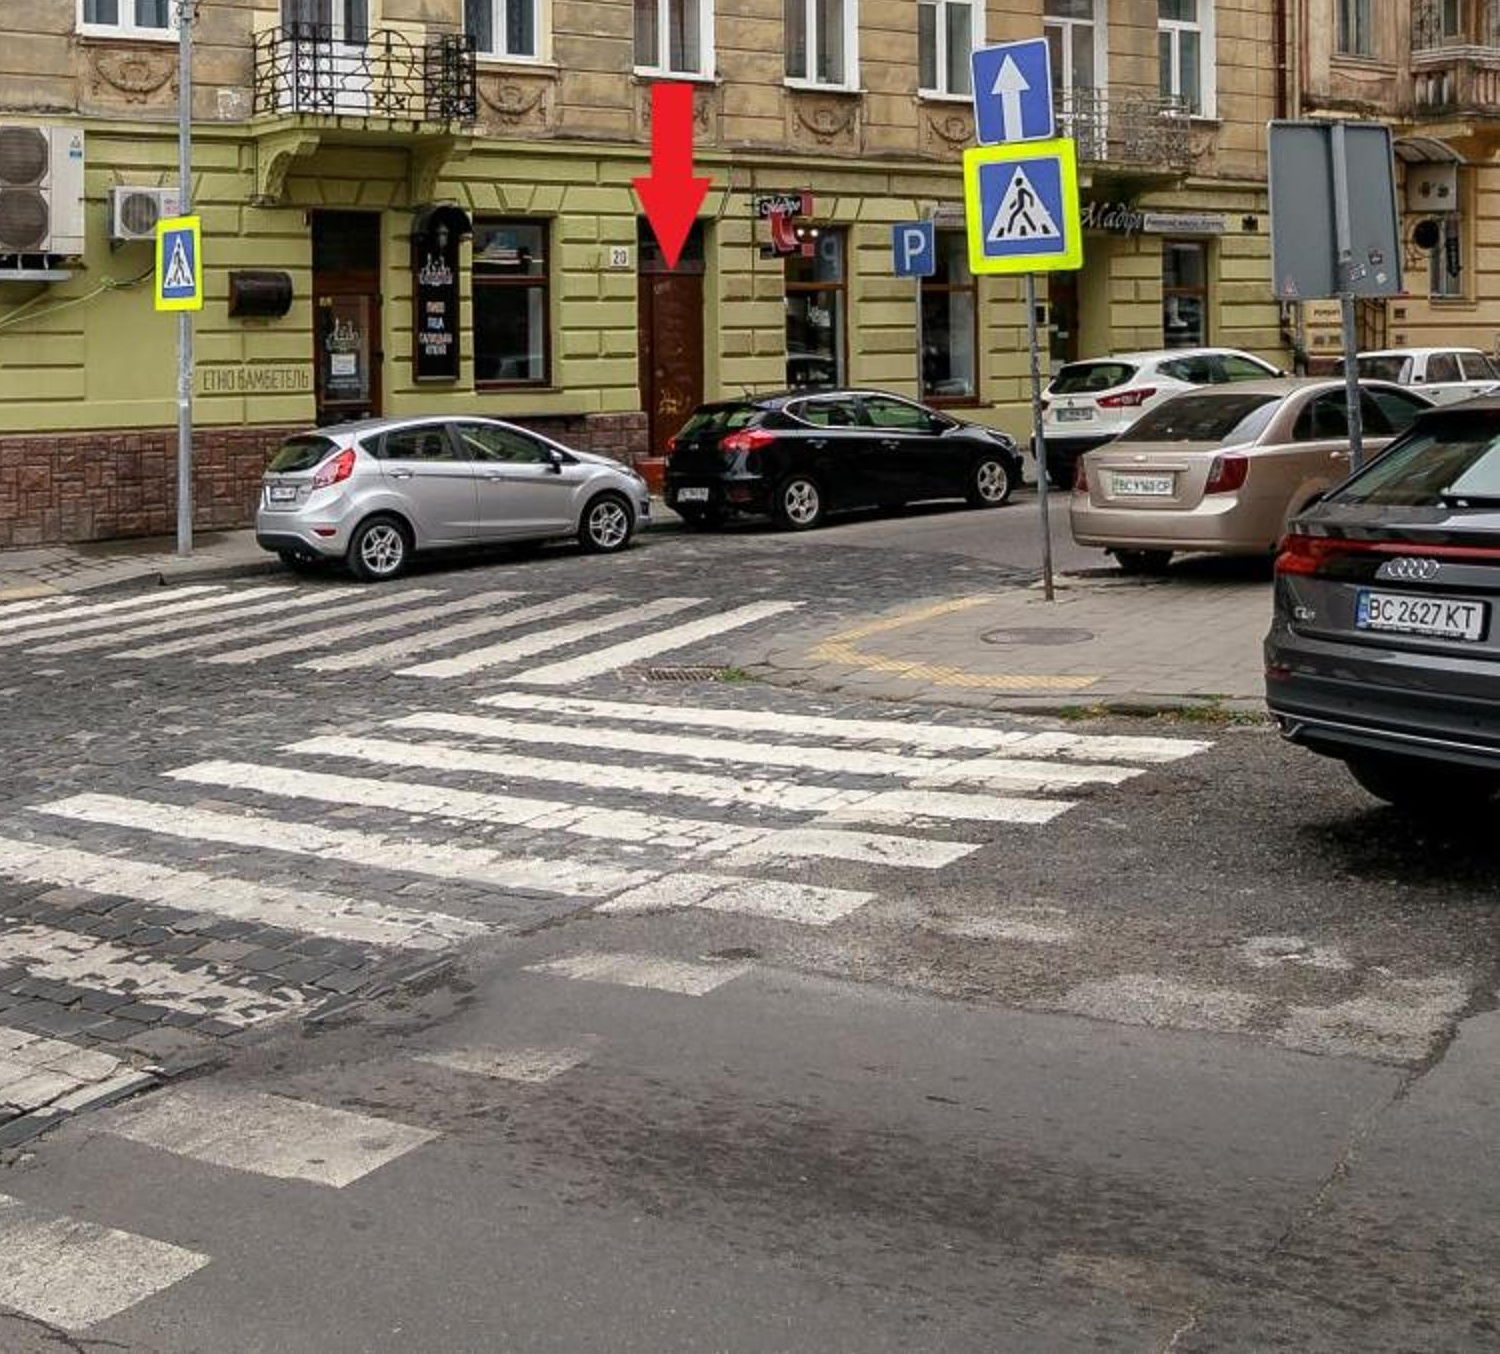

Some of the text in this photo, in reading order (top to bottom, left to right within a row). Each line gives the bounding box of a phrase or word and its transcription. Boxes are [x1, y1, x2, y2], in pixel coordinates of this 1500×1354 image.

[613, 248, 627, 265] 20
[903, 229, 926, 271] P
[203, 369, 235, 391] ЕТНО
[237, 367, 309, 390] БАМБЕТЕЛЬ
[1368, 599, 1477, 629] BC 2627 KT
